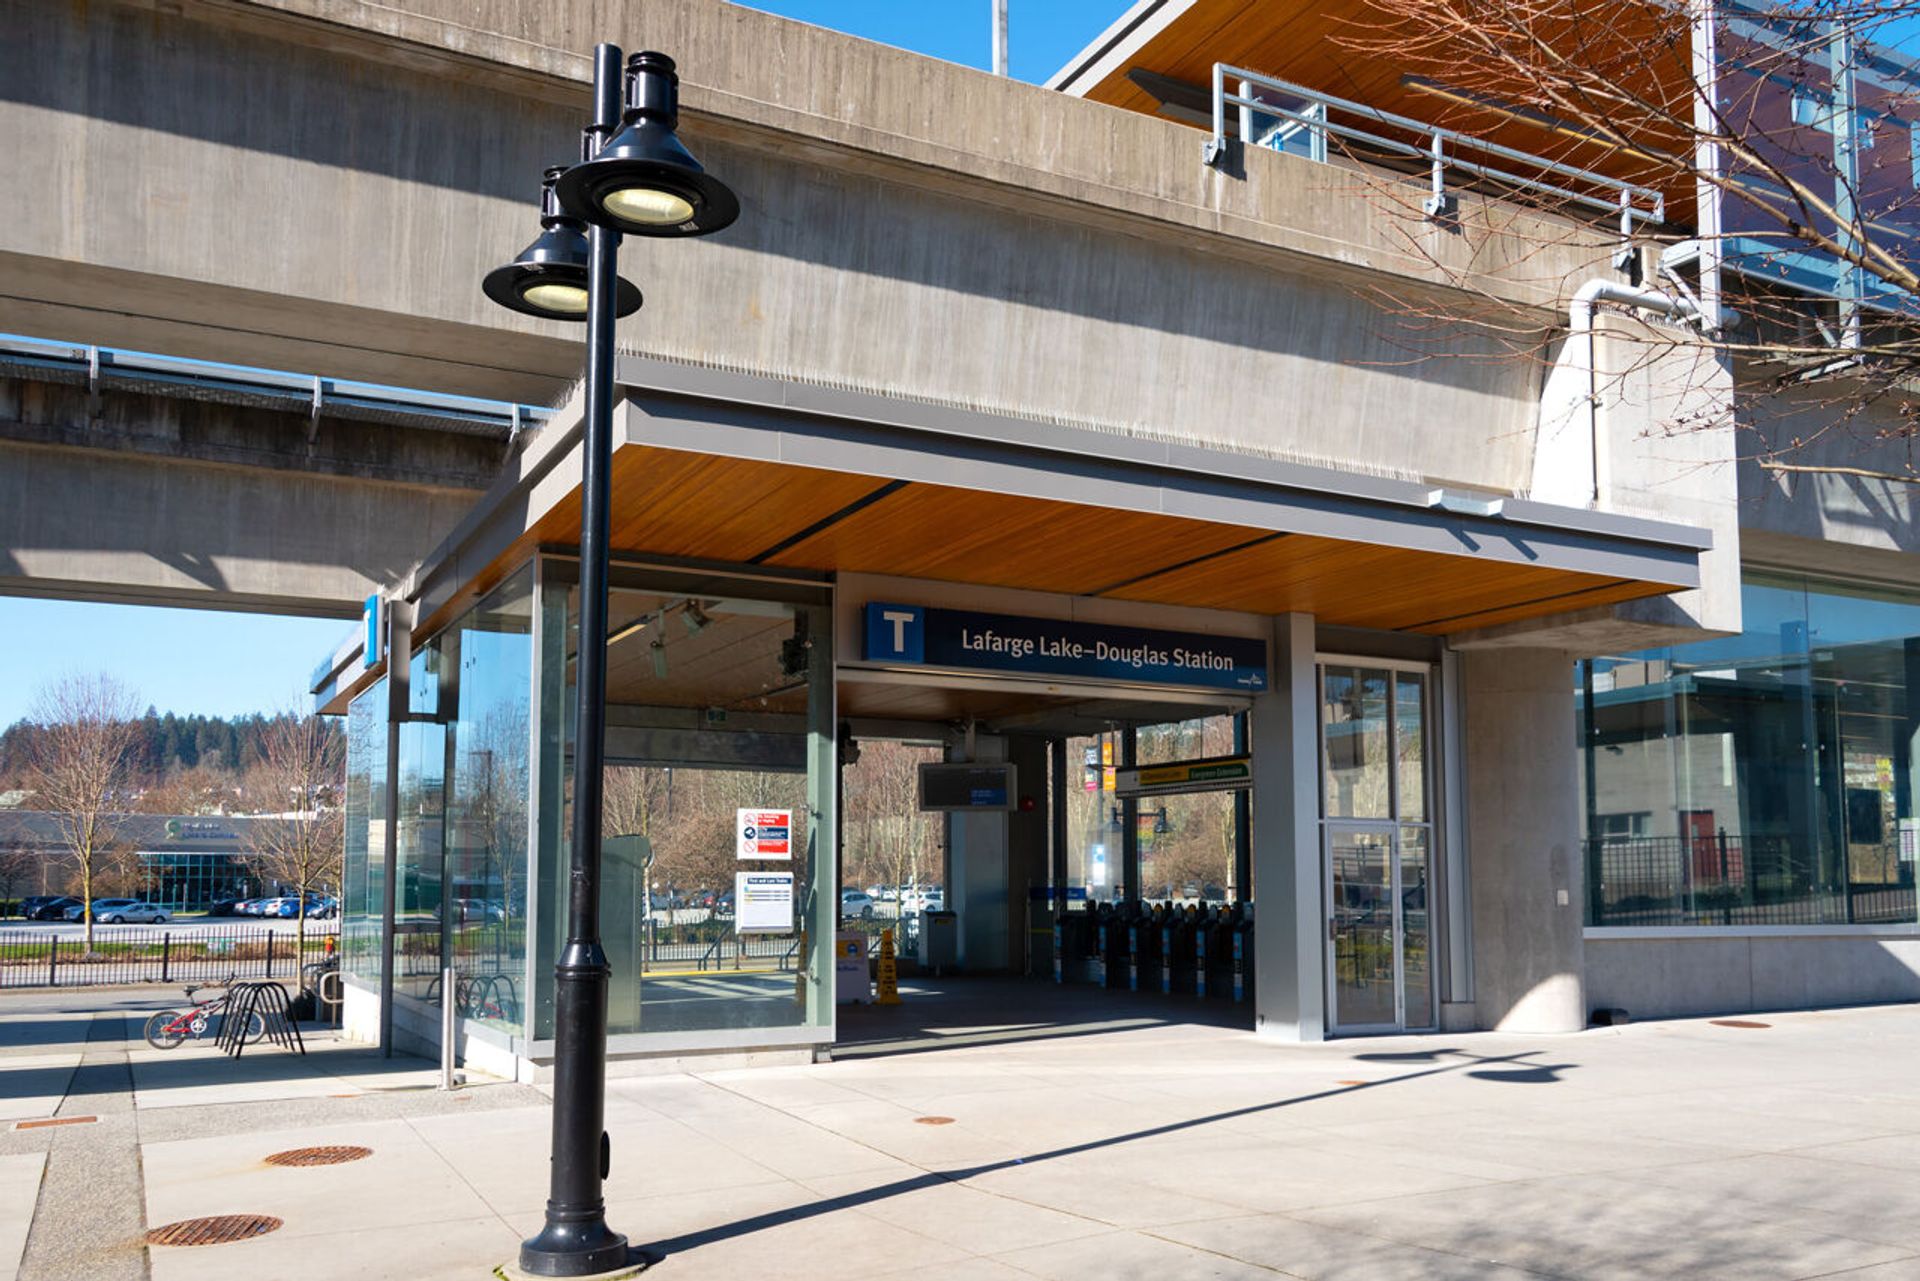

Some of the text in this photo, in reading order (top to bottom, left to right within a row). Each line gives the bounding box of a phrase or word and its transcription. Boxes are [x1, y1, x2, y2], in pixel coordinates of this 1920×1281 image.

[883, 611, 914, 652] T
[962, 628, 1034, 658] Lafarge
[1173, 648, 1233, 671] Station
